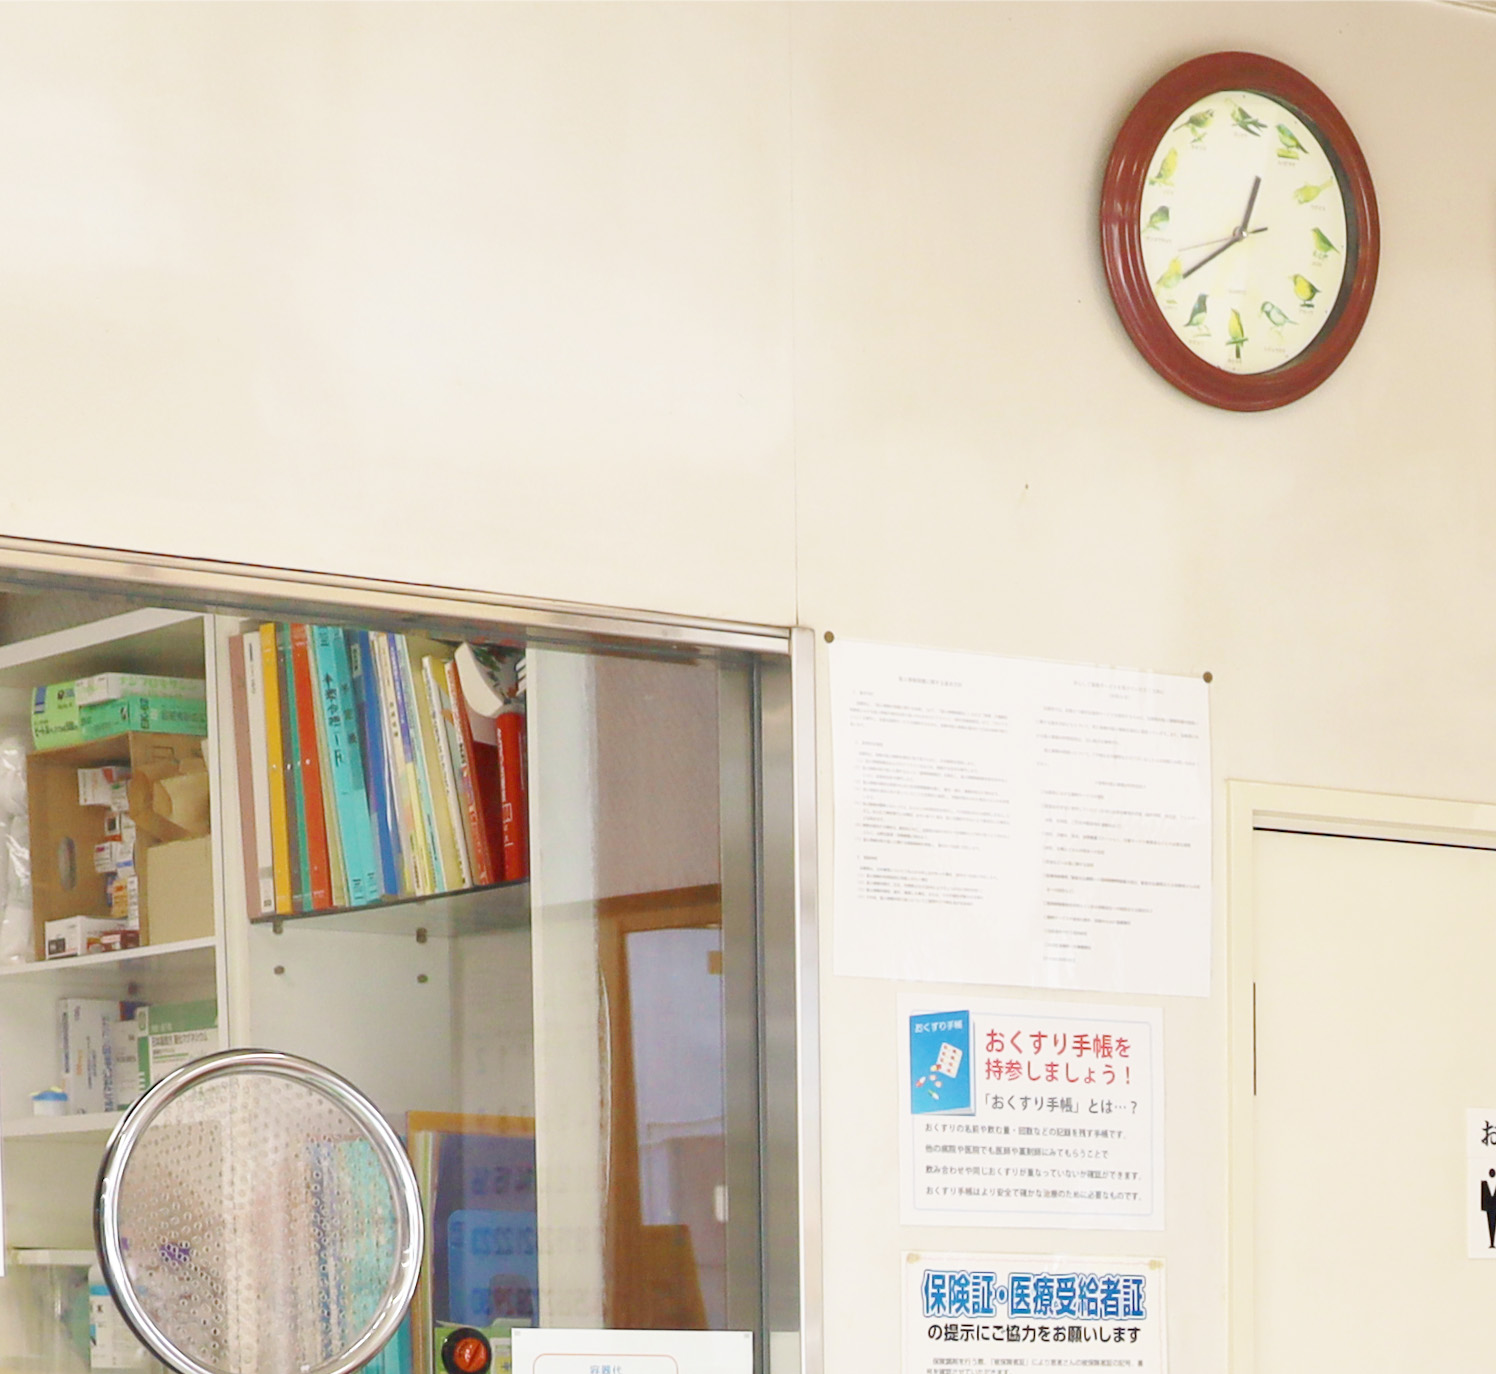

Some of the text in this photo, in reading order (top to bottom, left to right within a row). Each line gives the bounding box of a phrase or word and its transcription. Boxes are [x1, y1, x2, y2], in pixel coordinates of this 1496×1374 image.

[914, 1019, 964, 1034] おくすり手帳
[985, 1028, 1133, 1060] おくすり手帳を
[984, 1057, 1132, 1086] 持参しましょう！
[922, 1271, 1146, 1319] 保険証・医療受給者証
[928, 1323, 1142, 1344] の提示にご協力をお願いします
